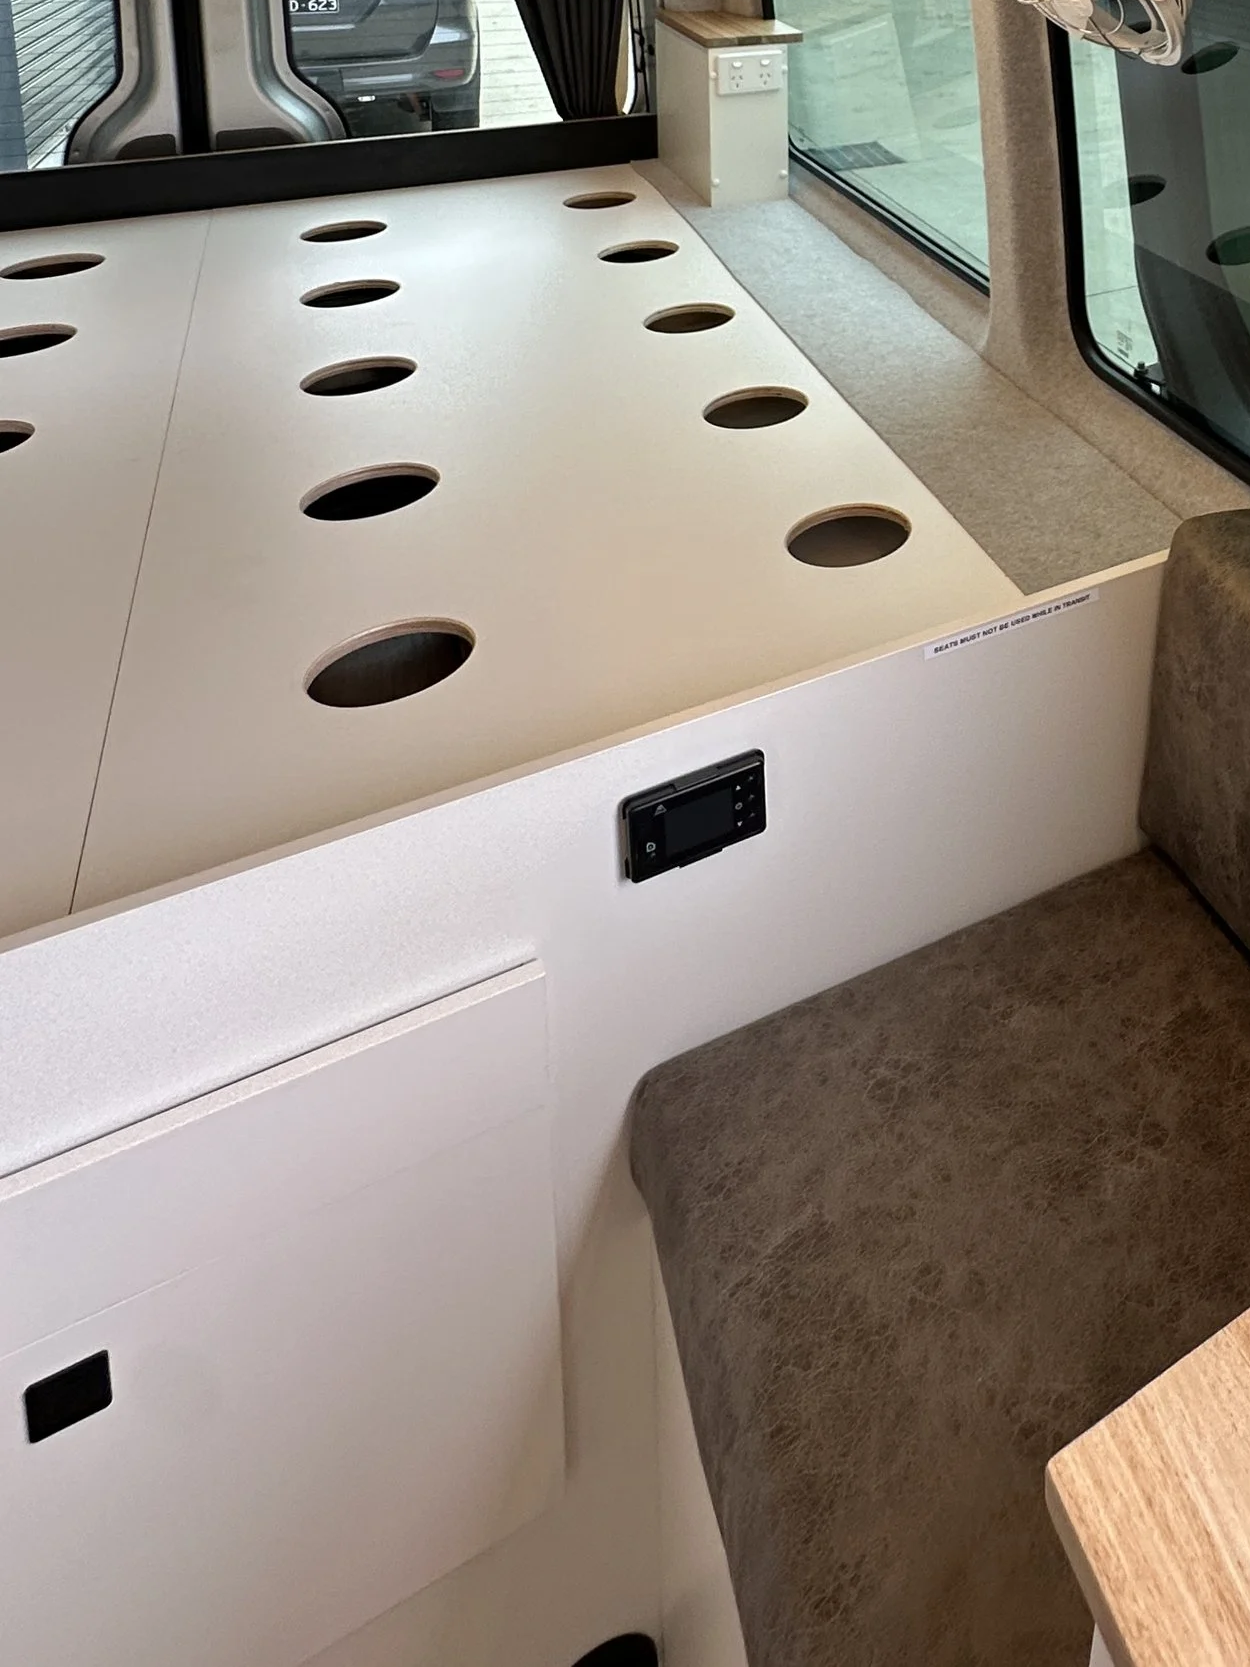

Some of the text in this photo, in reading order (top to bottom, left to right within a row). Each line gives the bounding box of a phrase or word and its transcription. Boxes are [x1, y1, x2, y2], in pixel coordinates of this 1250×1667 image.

[934, 594, 1091, 654] SEATS MUST NOT BE USED WHILE IN TRANSIT
